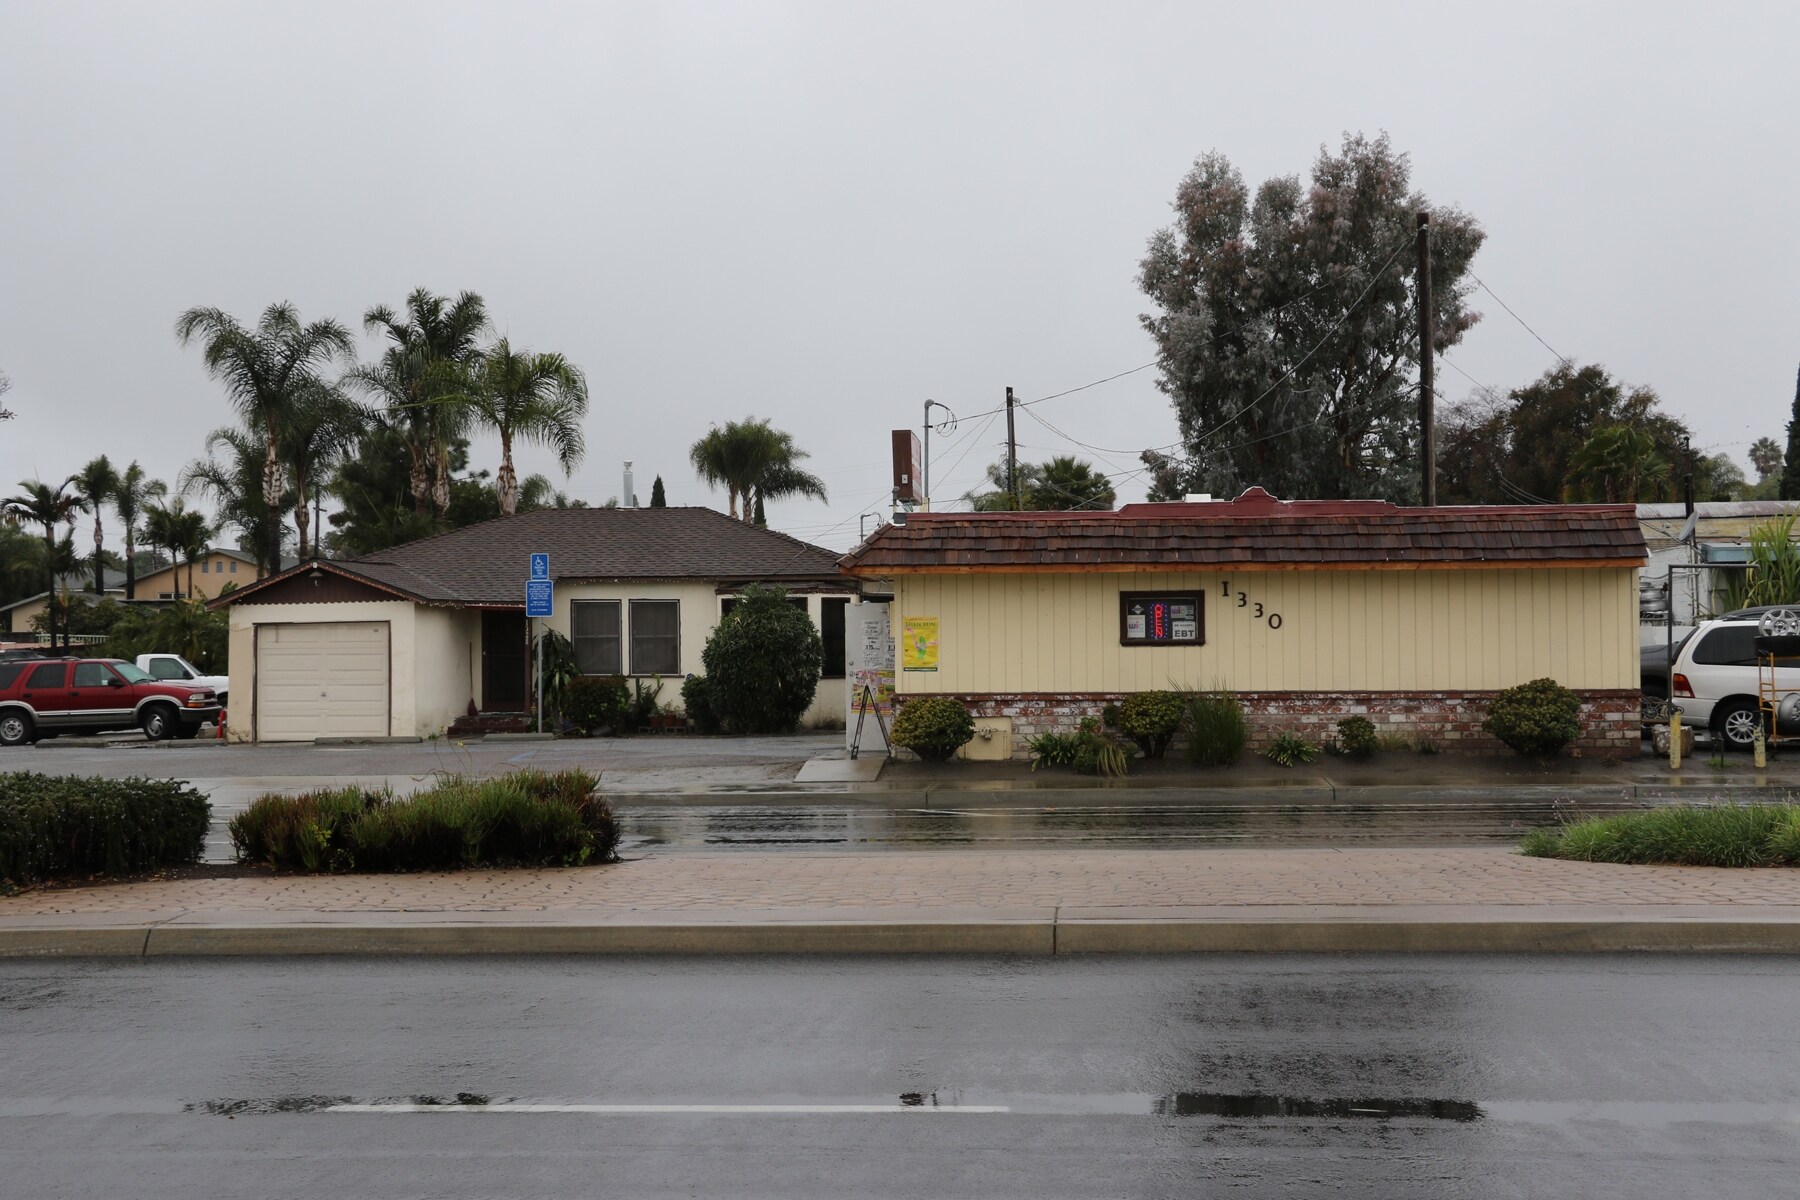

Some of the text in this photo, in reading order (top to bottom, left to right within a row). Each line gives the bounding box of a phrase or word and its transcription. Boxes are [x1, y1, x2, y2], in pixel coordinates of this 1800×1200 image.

[1154, 603, 1163, 638] OPEN
[1221, 580, 1283, 630] 1330
[1174, 629, 1195, 637] EBT
